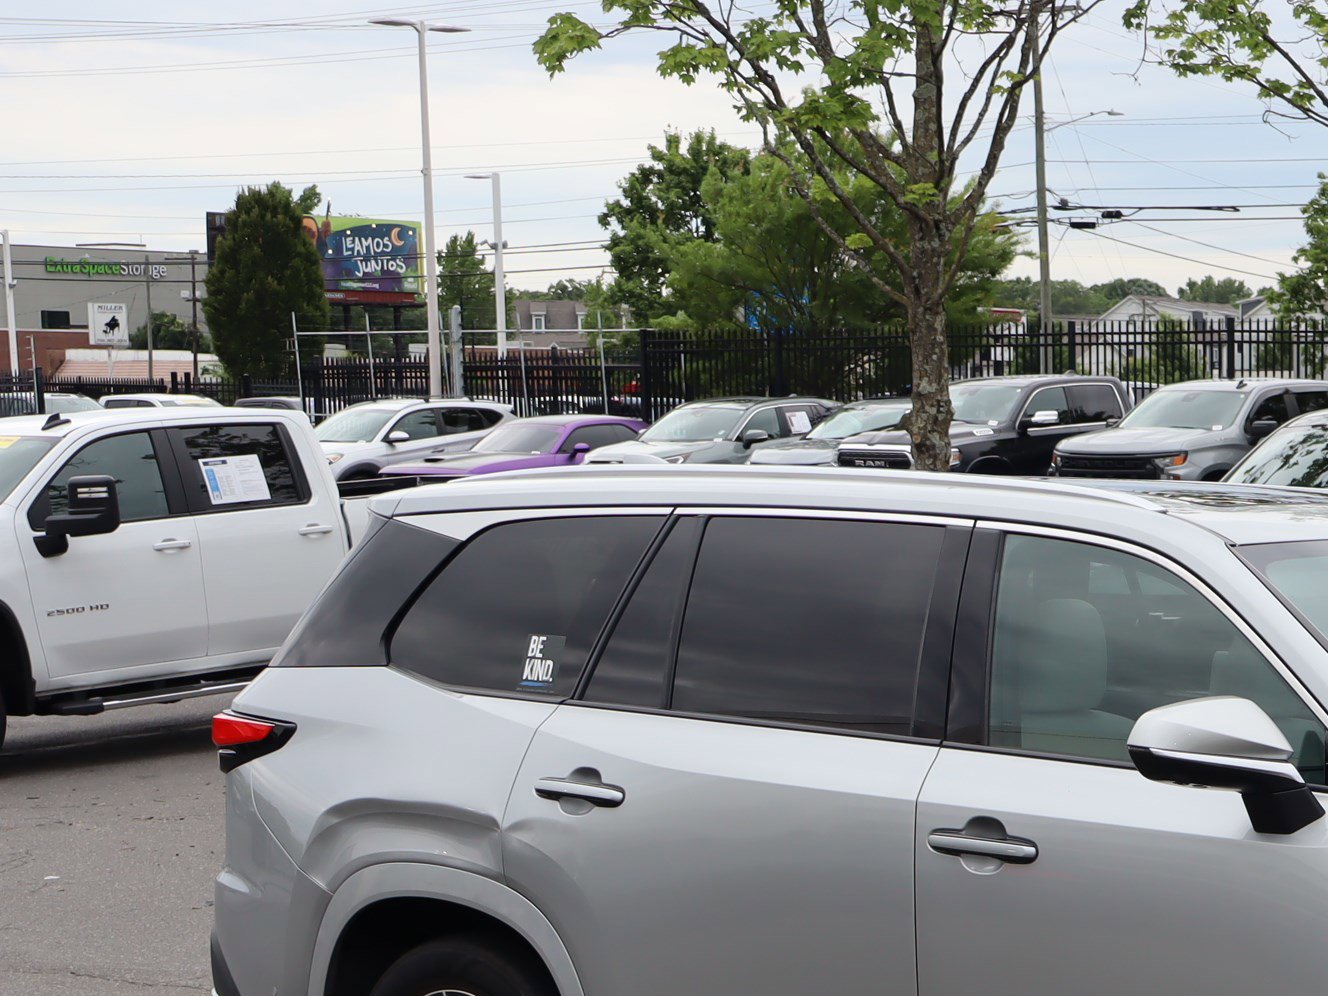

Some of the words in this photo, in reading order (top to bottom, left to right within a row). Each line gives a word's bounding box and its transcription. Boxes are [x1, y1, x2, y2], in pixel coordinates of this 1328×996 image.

[342, 237, 392, 255] LEAMOS
[353, 256, 406, 278] JUNTOS
[46, 606, 85, 617] 2500
[89, 603, 110, 611] HD
[527, 636, 547, 658] BE
[523, 658, 554, 682] KIND.
